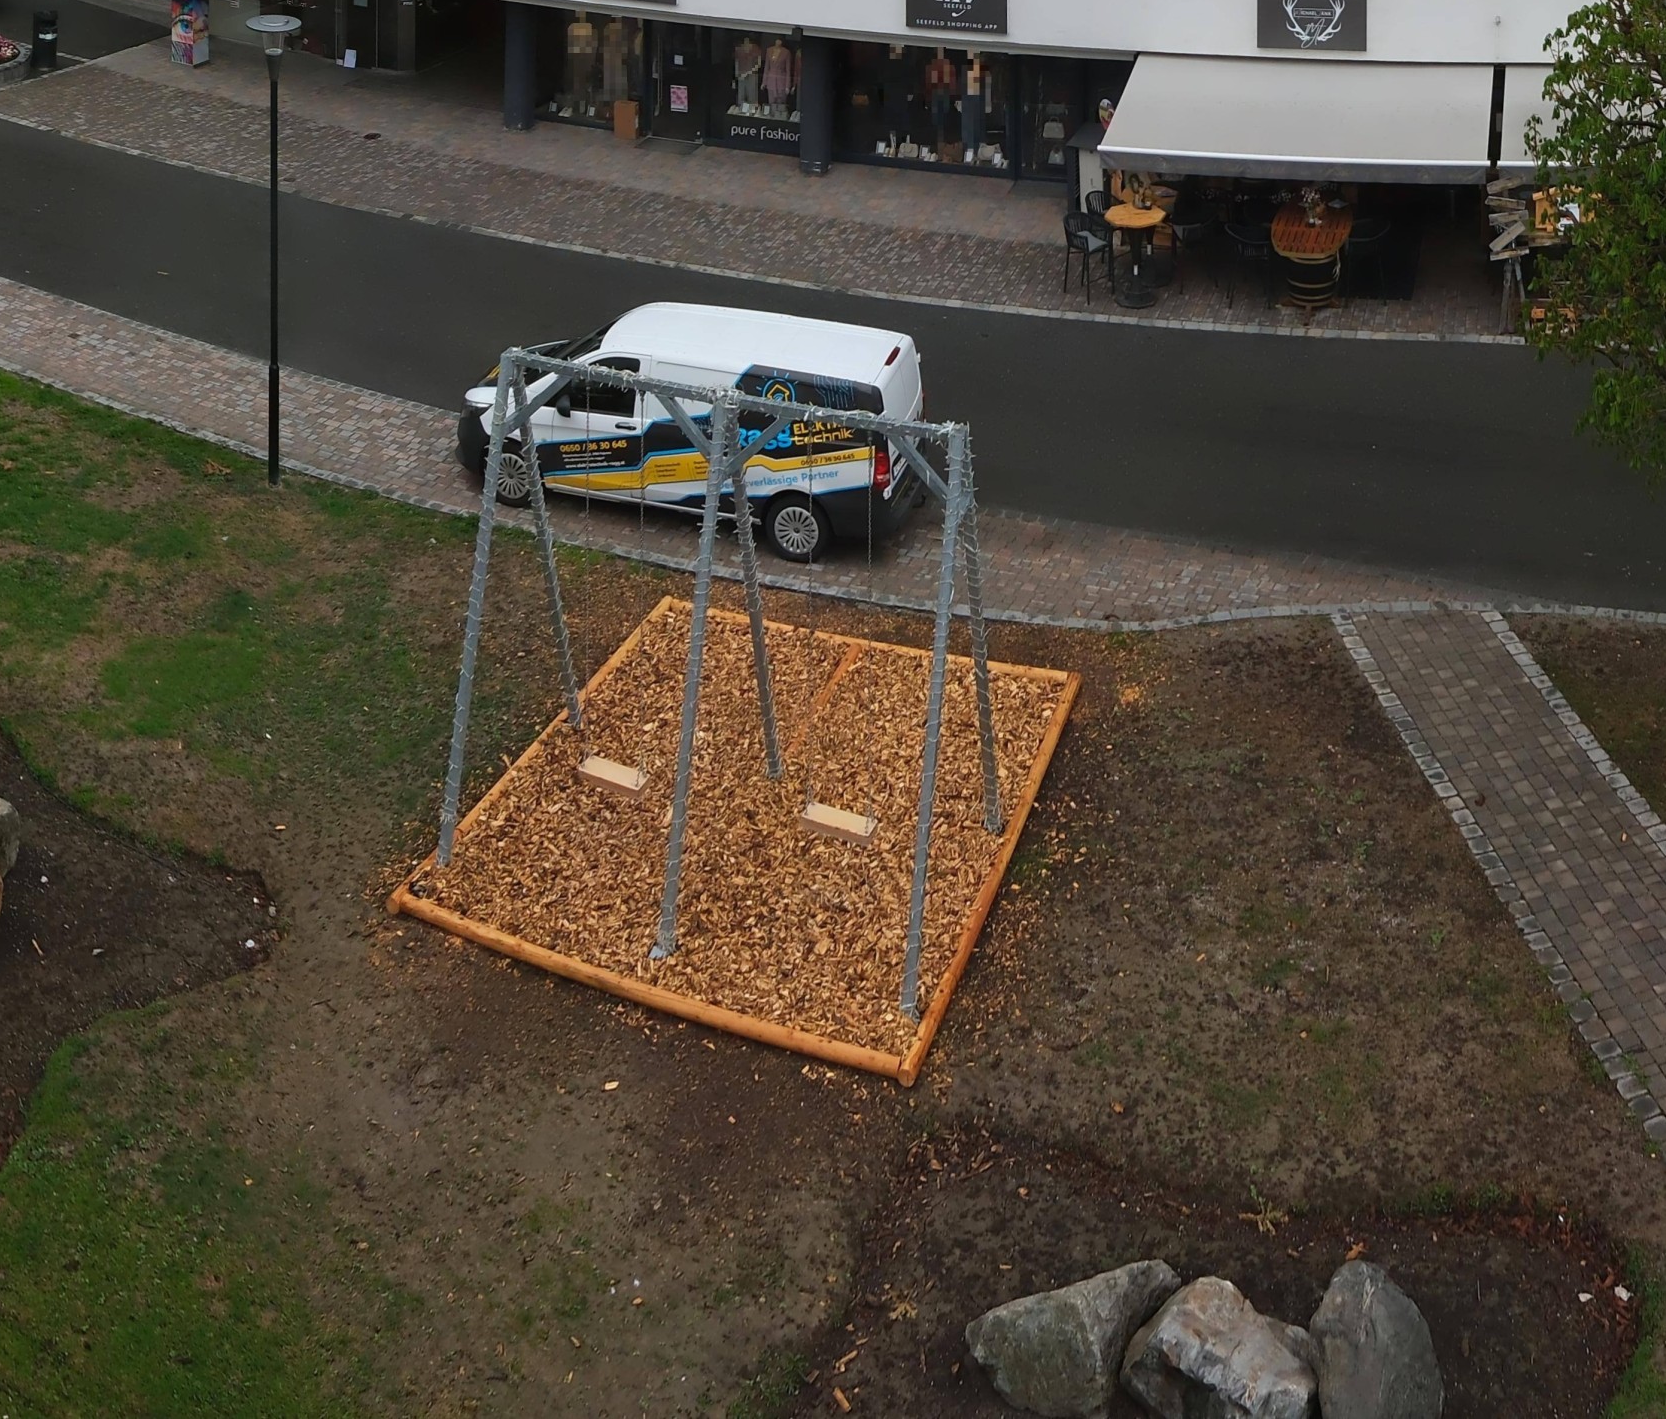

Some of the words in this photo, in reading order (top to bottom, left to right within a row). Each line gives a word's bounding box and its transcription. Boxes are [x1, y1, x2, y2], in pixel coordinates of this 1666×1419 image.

[947, 21, 982, 29] SHOPPING
[731, 125, 757, 137] pure
[559, 444, 581, 453] 0650
[599, 441, 609, 449] 30
[611, 439, 627, 449] 645
[746, 475, 799, 488] verlässige
[801, 470, 839, 483] Partner
